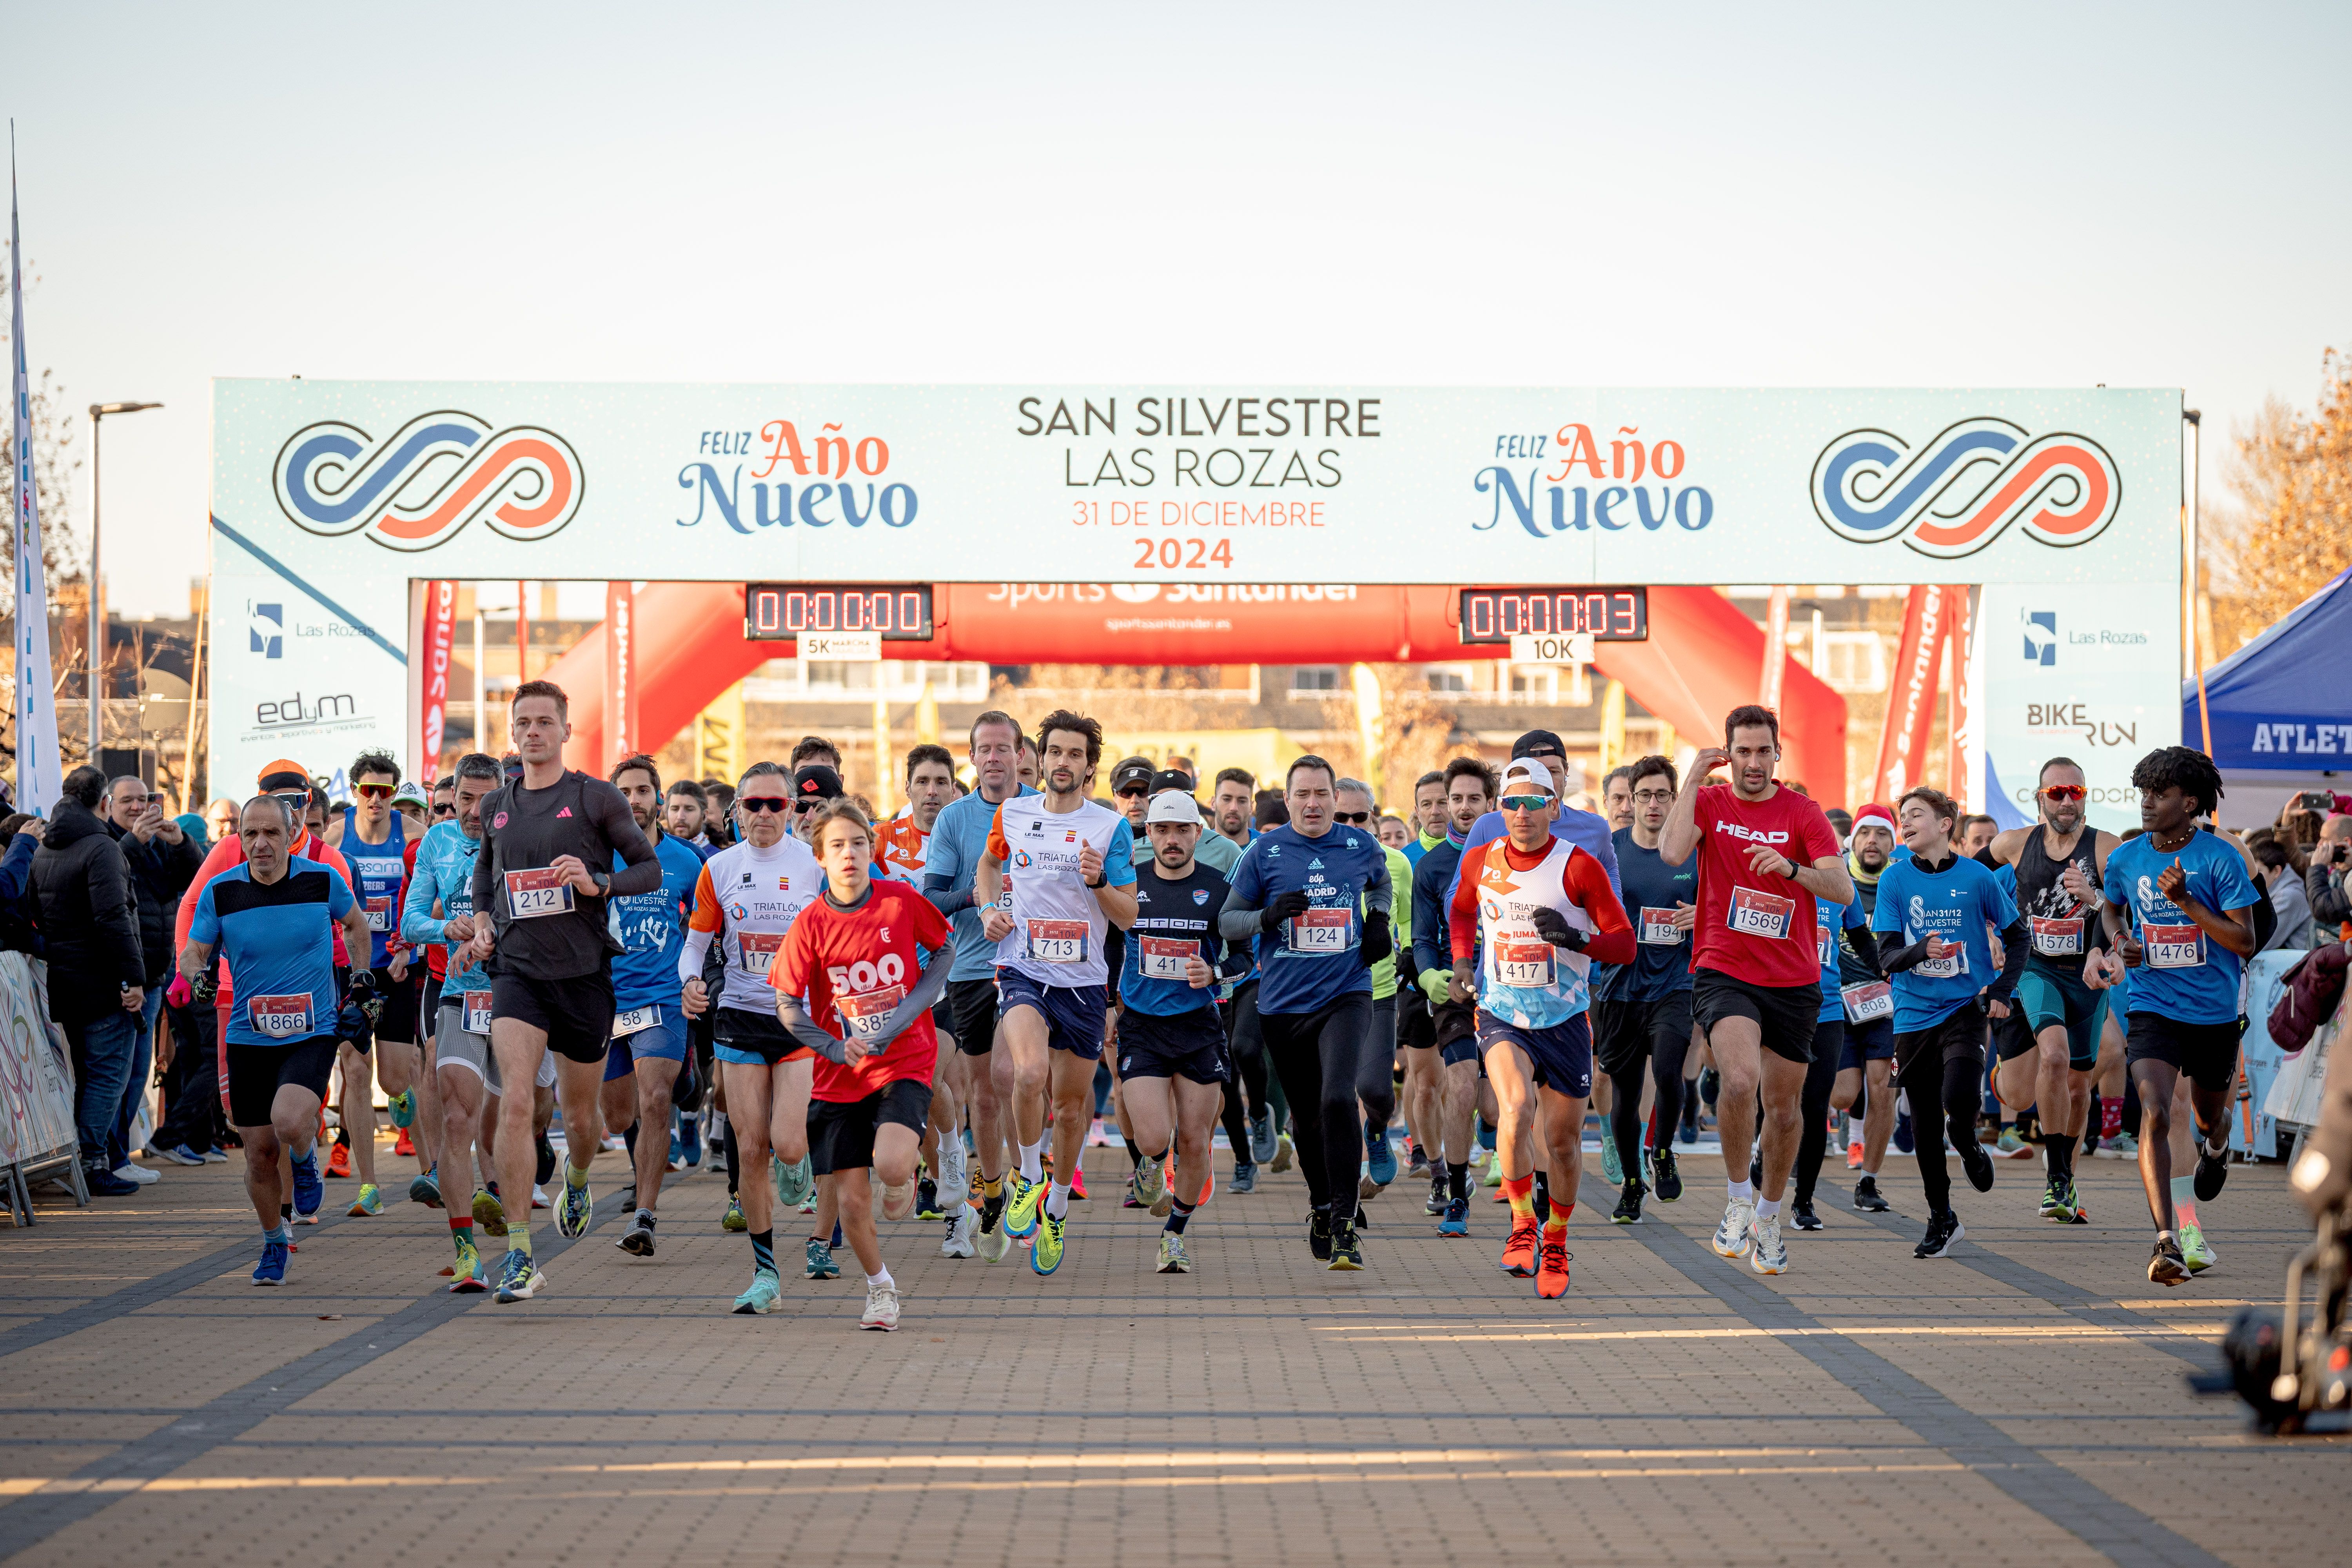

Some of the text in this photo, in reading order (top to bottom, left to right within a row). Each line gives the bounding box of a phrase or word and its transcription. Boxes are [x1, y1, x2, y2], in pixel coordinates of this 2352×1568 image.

[1017, 397, 1381, 437] SAN SILVESTRE
[700, 419, 889, 480] FELIZ Año
[1495, 423, 1684, 484] FELIZ Año
[1066, 448, 1342, 487] LAS ROZAS
[677, 463, 918, 534] Nuevo
[1472, 466, 1713, 538] Nuevo
[1073, 501, 1325, 526] 31 DE DICIEMBRE
[1134, 538, 1233, 568] 2024
[758, 591, 921, 631] 00:00:00
[1471, 593, 1635, 637] 00:00:03
[297, 623, 375, 637] Las Rozas
[2069, 630, 2147, 644] Las Rozas
[809, 640, 829, 653] 5K
[1534, 639, 1573, 659] 10K
[2028, 704, 2086, 726] BIKE
[2085, 721, 2136, 746] RUN
[2017, 788, 2136, 802] CDOR
[1716, 820, 1789, 843] HEAD
[1308, 873, 1324, 884] edp
[521, 889, 555, 908] 212
[996, 893, 1013, 907] 5
[753, 902, 801, 912] TRIATLÓN
[1509, 902, 1546, 912] TRIAT
[1766, 905, 1781, 914] 10k
[1740, 909, 1780, 929] 1569
[1307, 928, 1337, 943] 124
[1654, 925, 1679, 937] 194
[1041, 940, 1073, 955] 713
[2039, 935, 2074, 948] 1578
[2152, 944, 2194, 959] 1476
[749, 952, 775, 967] 17
[1157, 957, 1176, 971] 41
[1923, 959, 1951, 970] 669
[1507, 963, 1539, 978] 417
[874, 1002, 892, 1011] 10k
[1861, 998, 1886, 1013] 808
[261, 1014, 303, 1029] 1866
[622, 1011, 641, 1026] 58
[858, 1012, 891, 1033] 385
